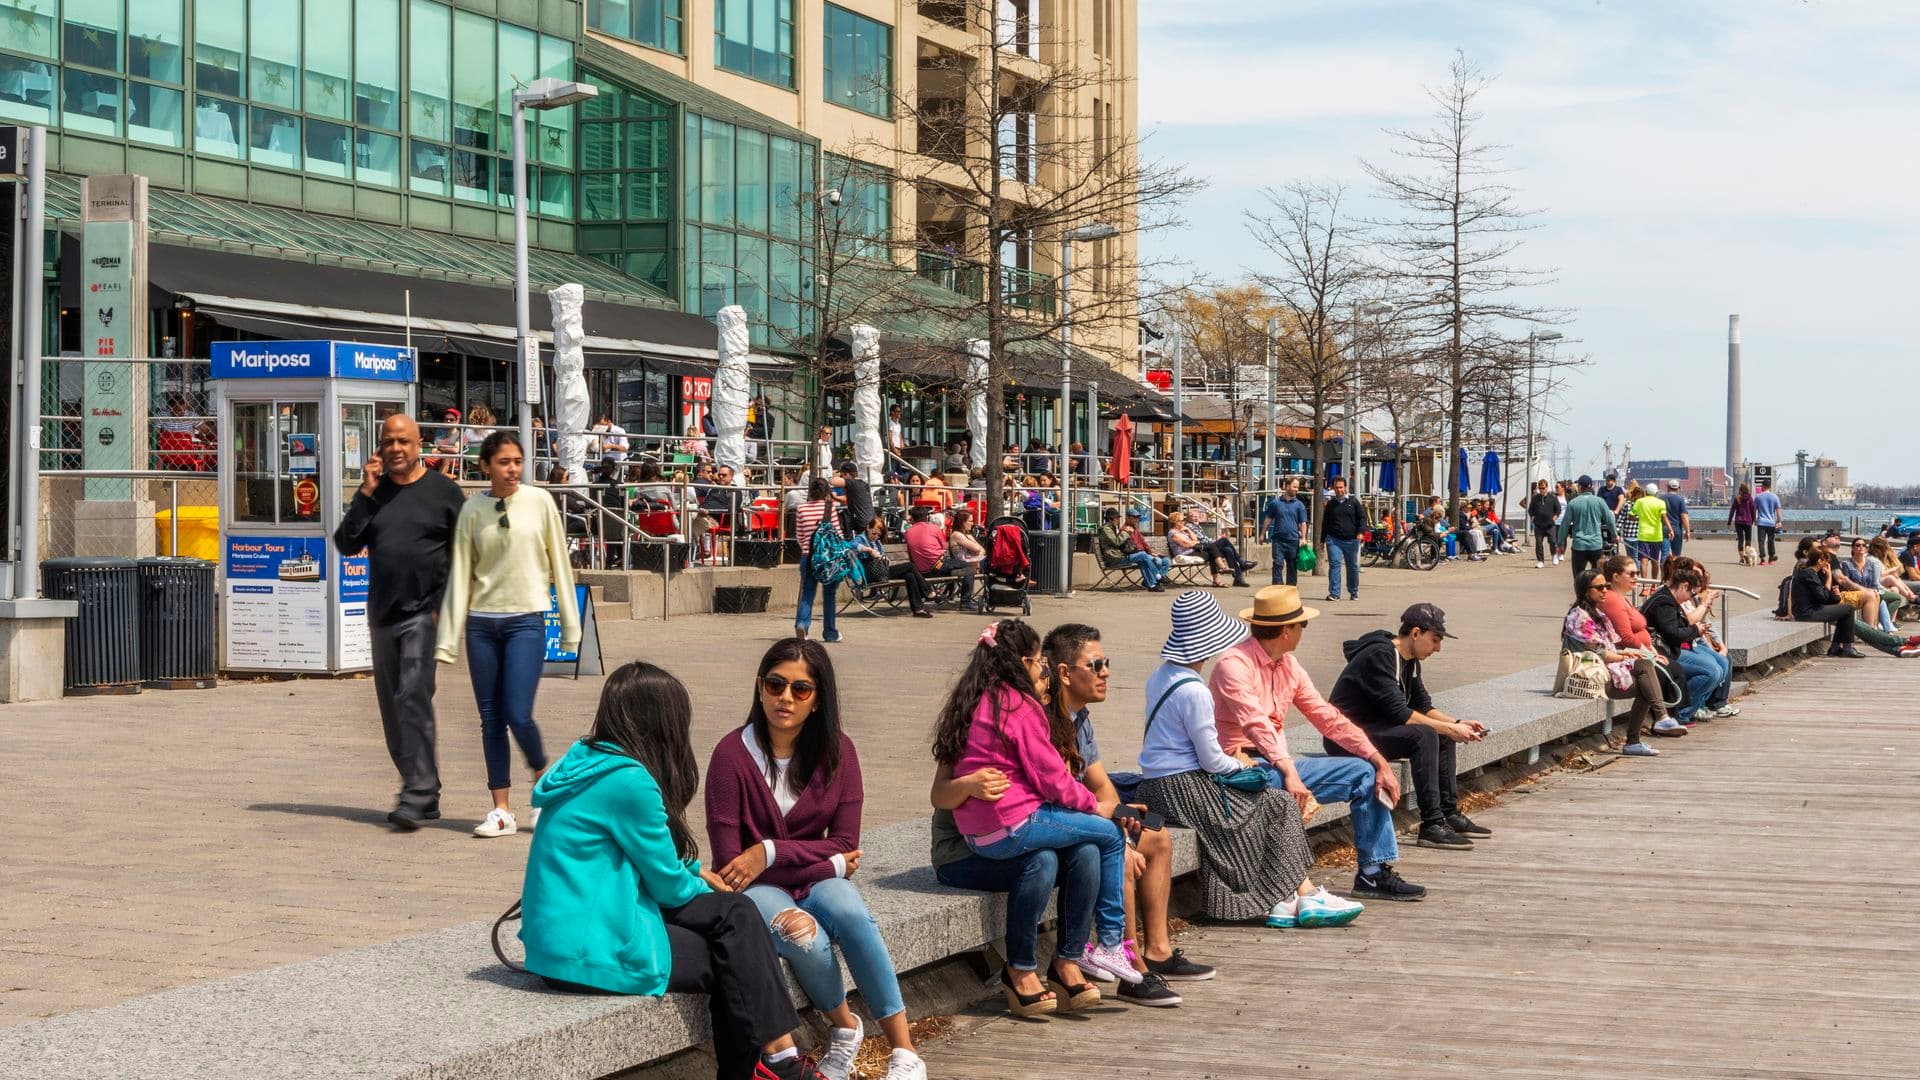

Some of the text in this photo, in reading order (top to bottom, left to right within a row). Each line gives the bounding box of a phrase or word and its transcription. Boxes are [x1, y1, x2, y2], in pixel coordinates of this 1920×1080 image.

[91, 200, 129, 208] TERMINAL
[98, 337, 114, 346] PIE
[231, 350, 311, 373] Mariposa
[354, 351, 397, 374] Mariposa
[232, 543, 285, 553] Harbour Tours
[343, 561, 367, 576] Tours
